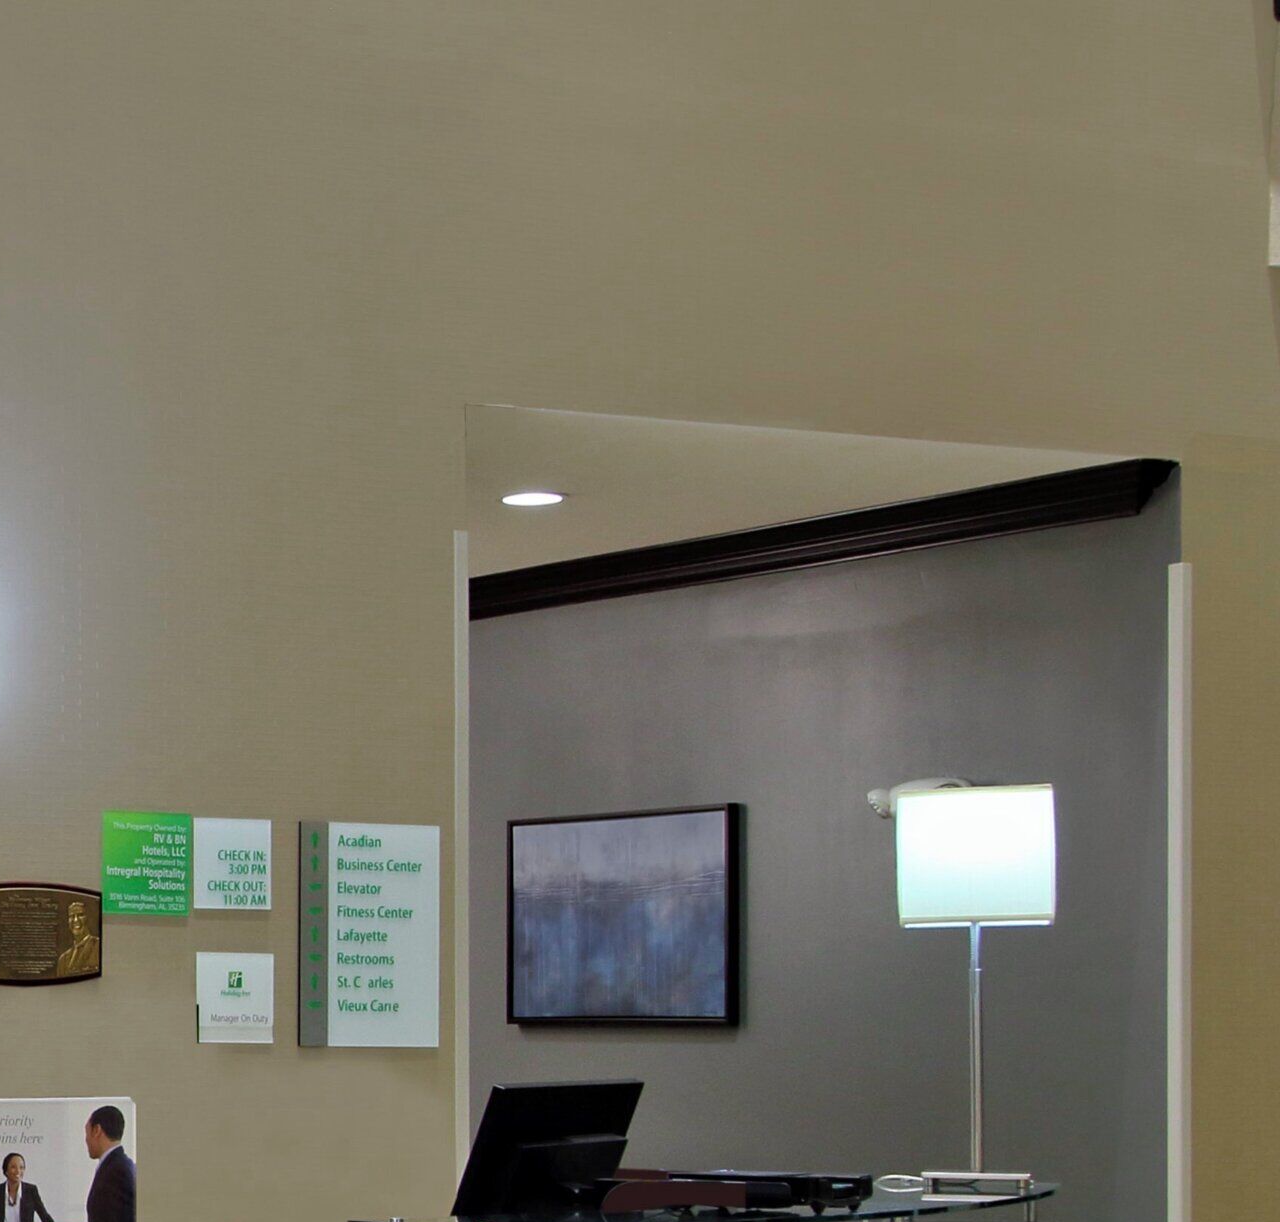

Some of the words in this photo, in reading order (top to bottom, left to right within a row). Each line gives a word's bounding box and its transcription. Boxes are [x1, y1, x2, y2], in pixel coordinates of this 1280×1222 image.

[154, 833, 165, 844] RV
[166, 834, 173, 844] &
[174, 834, 186, 844] BN
[338, 835, 382, 848] Acadian
[142, 845, 170, 857] Hotels,
[172, 846, 186, 857] LLC
[218, 850, 251, 861] CHECK
[253, 850, 266, 862] IN:
[147, 858, 175, 867] Operated
[337, 858, 384, 871] Business
[386, 860, 422, 872] Center
[142, 867, 186, 880] Hospitality
[229, 864, 249, 874] 3:00
[251, 864, 266, 875] PM
[148, 880, 185, 891] Solutions
[208, 880, 240, 891] CHECK
[242, 881, 266, 892] OUT:
[337, 882, 382, 894] Elevator
[224, 894, 248, 905] 11:00
[250, 895, 266, 906] AM
[337, 905, 374, 918] Fitness
[378, 906, 414, 918] Center
[337, 928, 388, 944] Lafayette
[337, 952, 394, 965] Restrooms
[338, 976, 351, 988] St.
[338, 1000, 368, 1012] Vieux
[210, 1014, 239, 1024] Manager
[240, 1014, 251, 1022] On
[252, 1014, 268, 1024] Duty
[20, 1132, 44, 1144] here
